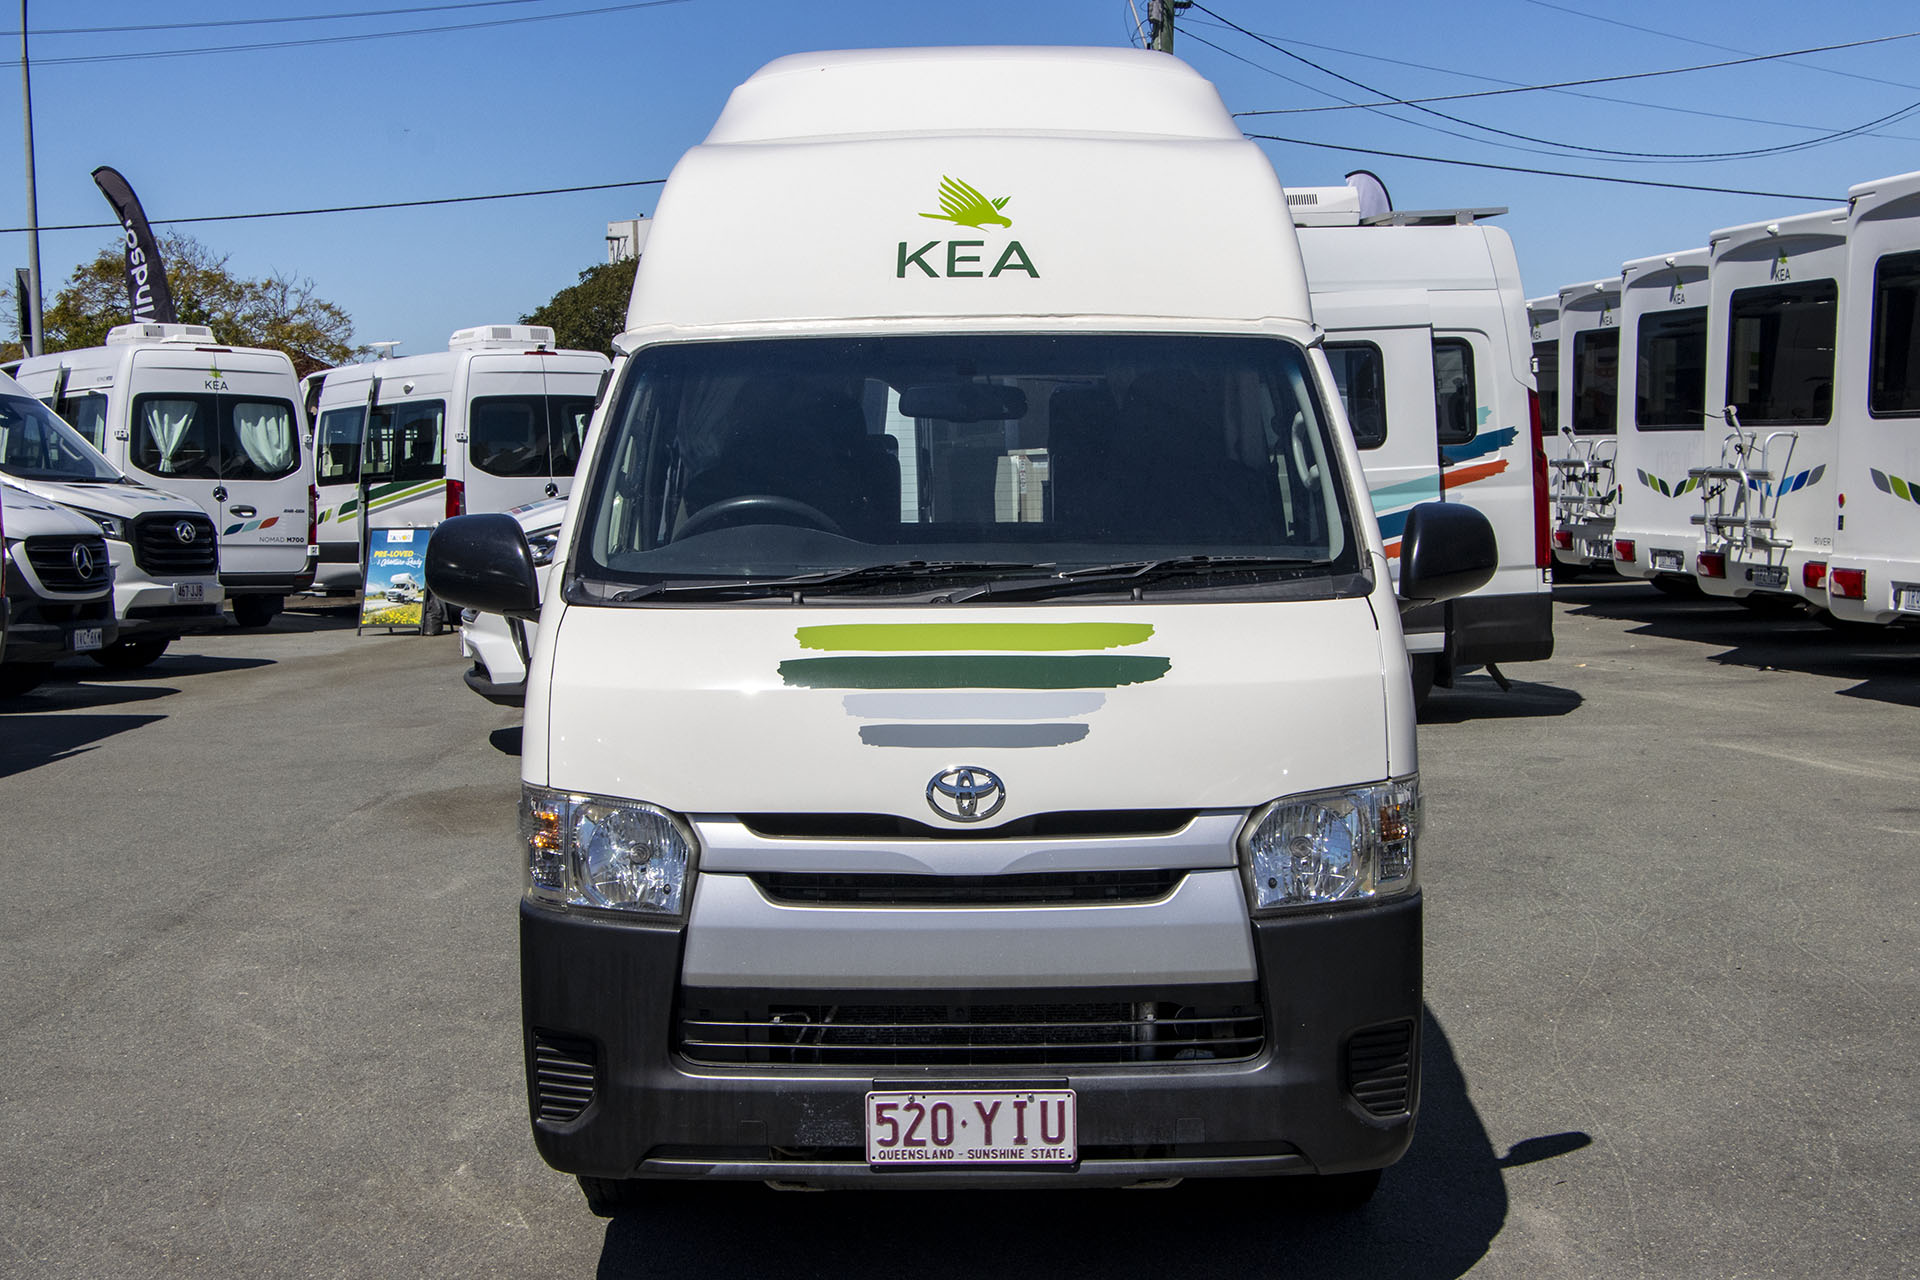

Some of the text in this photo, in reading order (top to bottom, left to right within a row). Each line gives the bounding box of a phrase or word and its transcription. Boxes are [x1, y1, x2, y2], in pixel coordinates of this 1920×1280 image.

[897, 240, 1040, 278] KEA
[126, 219, 156, 323] indso
[1775, 268, 1791, 282] KEA
[1673, 293, 1686, 304] KEA
[204, 380, 229, 391] KEA
[1813, 536, 1831, 546] RIVER
[878, 1149, 954, 1160] QUEENSLAND
[967, 1149, 1025, 1160] SUNSHINE
[1031, 1148, 1065, 1159] STATE
